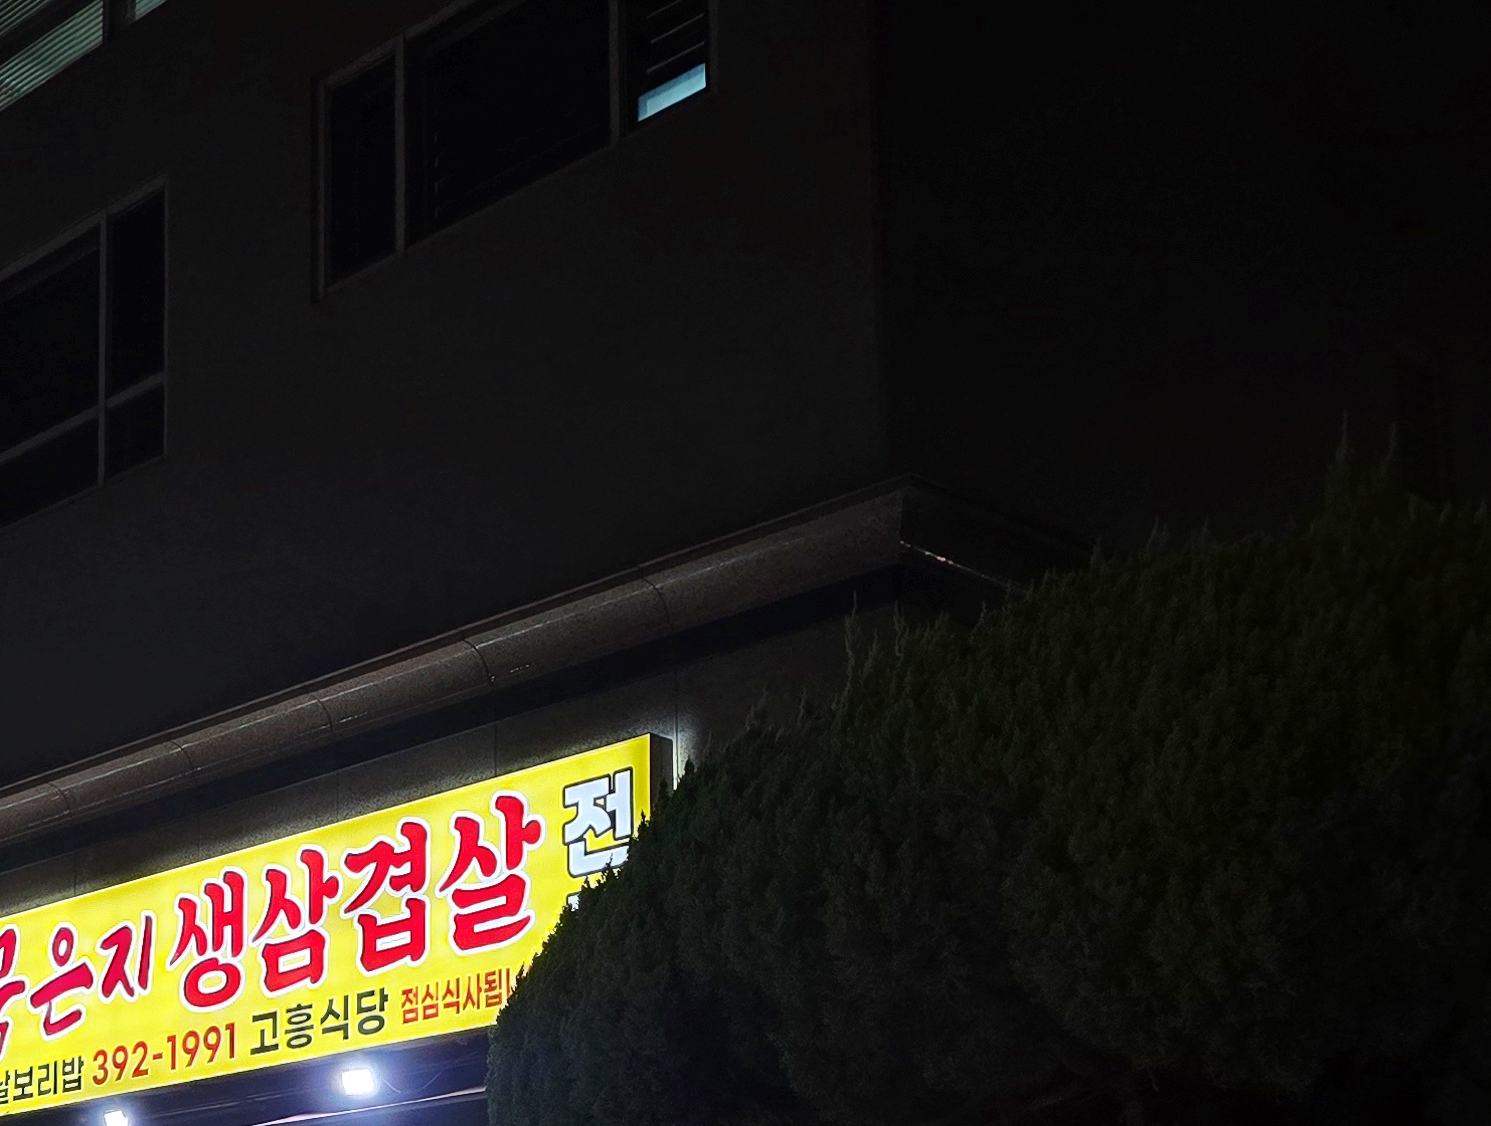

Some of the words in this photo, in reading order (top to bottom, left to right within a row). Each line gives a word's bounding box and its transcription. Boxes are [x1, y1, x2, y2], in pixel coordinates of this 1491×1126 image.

[168, 792, 542, 1008] 생삼겹살
[92, 1022, 236, 1086] 392-1991
[250, 987, 389, 1055] 고흥식당
[401, 967, 513, 1025] 점심식사됩
